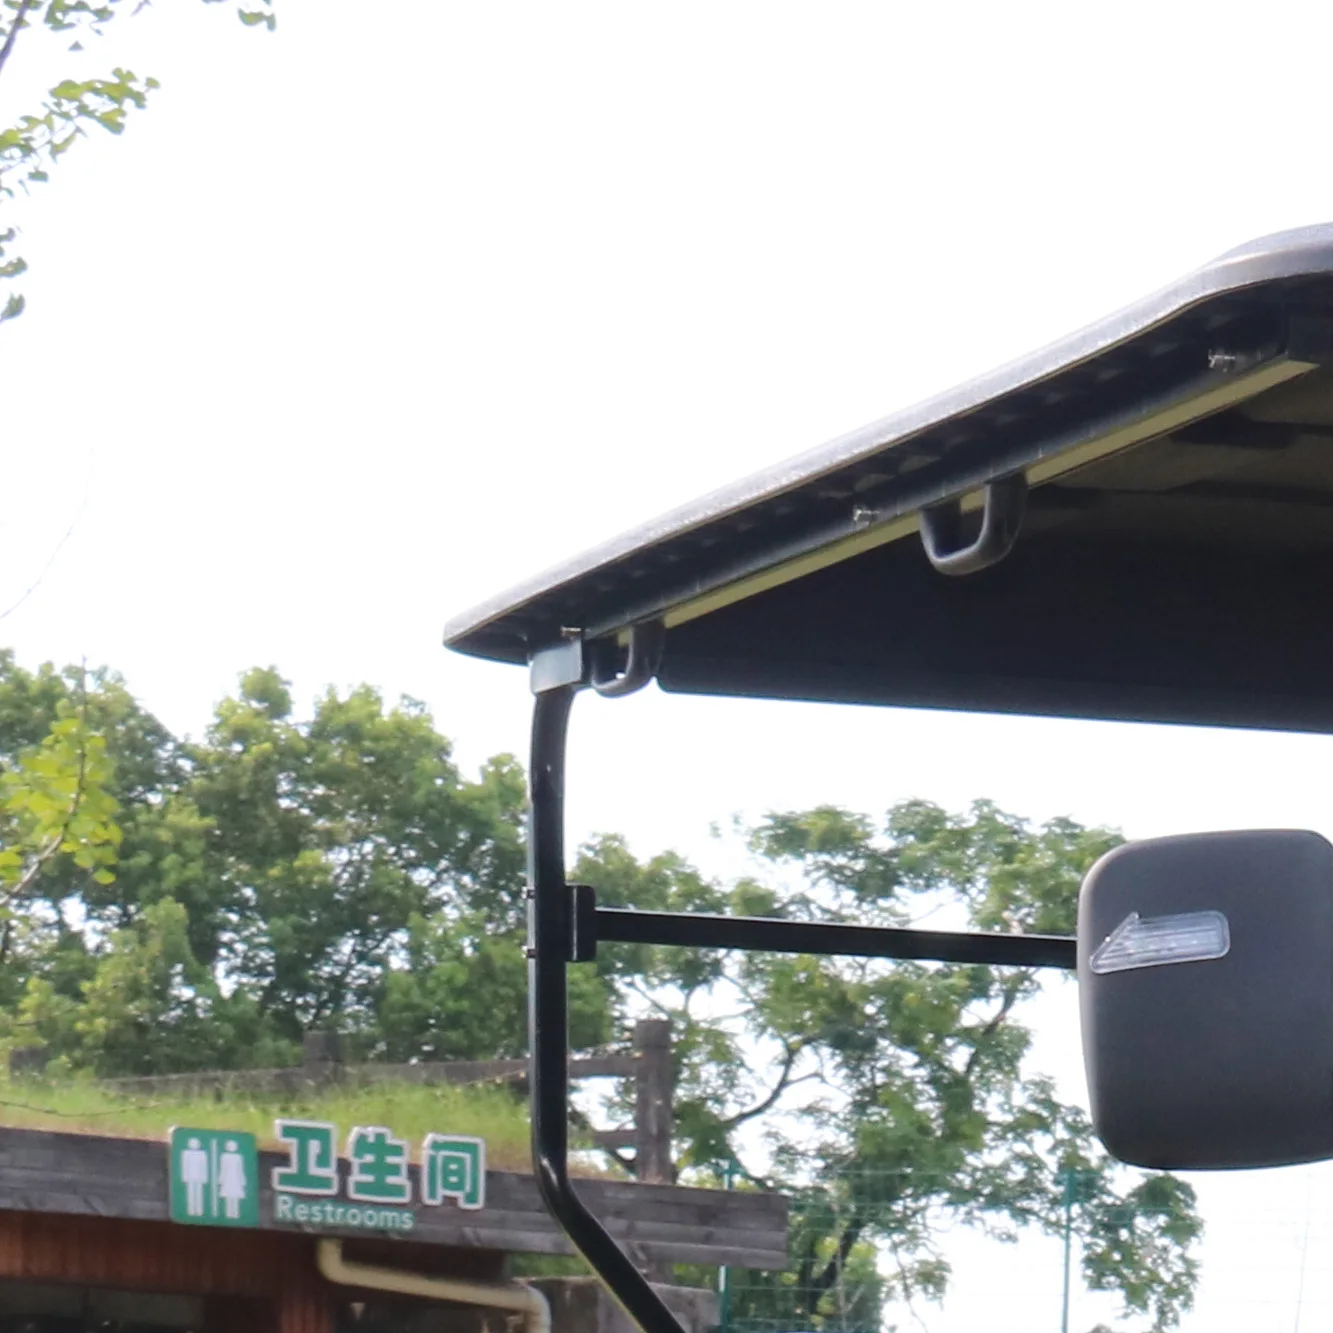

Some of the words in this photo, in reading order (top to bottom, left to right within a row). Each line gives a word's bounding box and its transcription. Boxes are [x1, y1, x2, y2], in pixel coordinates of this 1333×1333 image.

[272, 1118, 486, 1210] 卫生间
[276, 1196, 414, 1230] Restrooms
